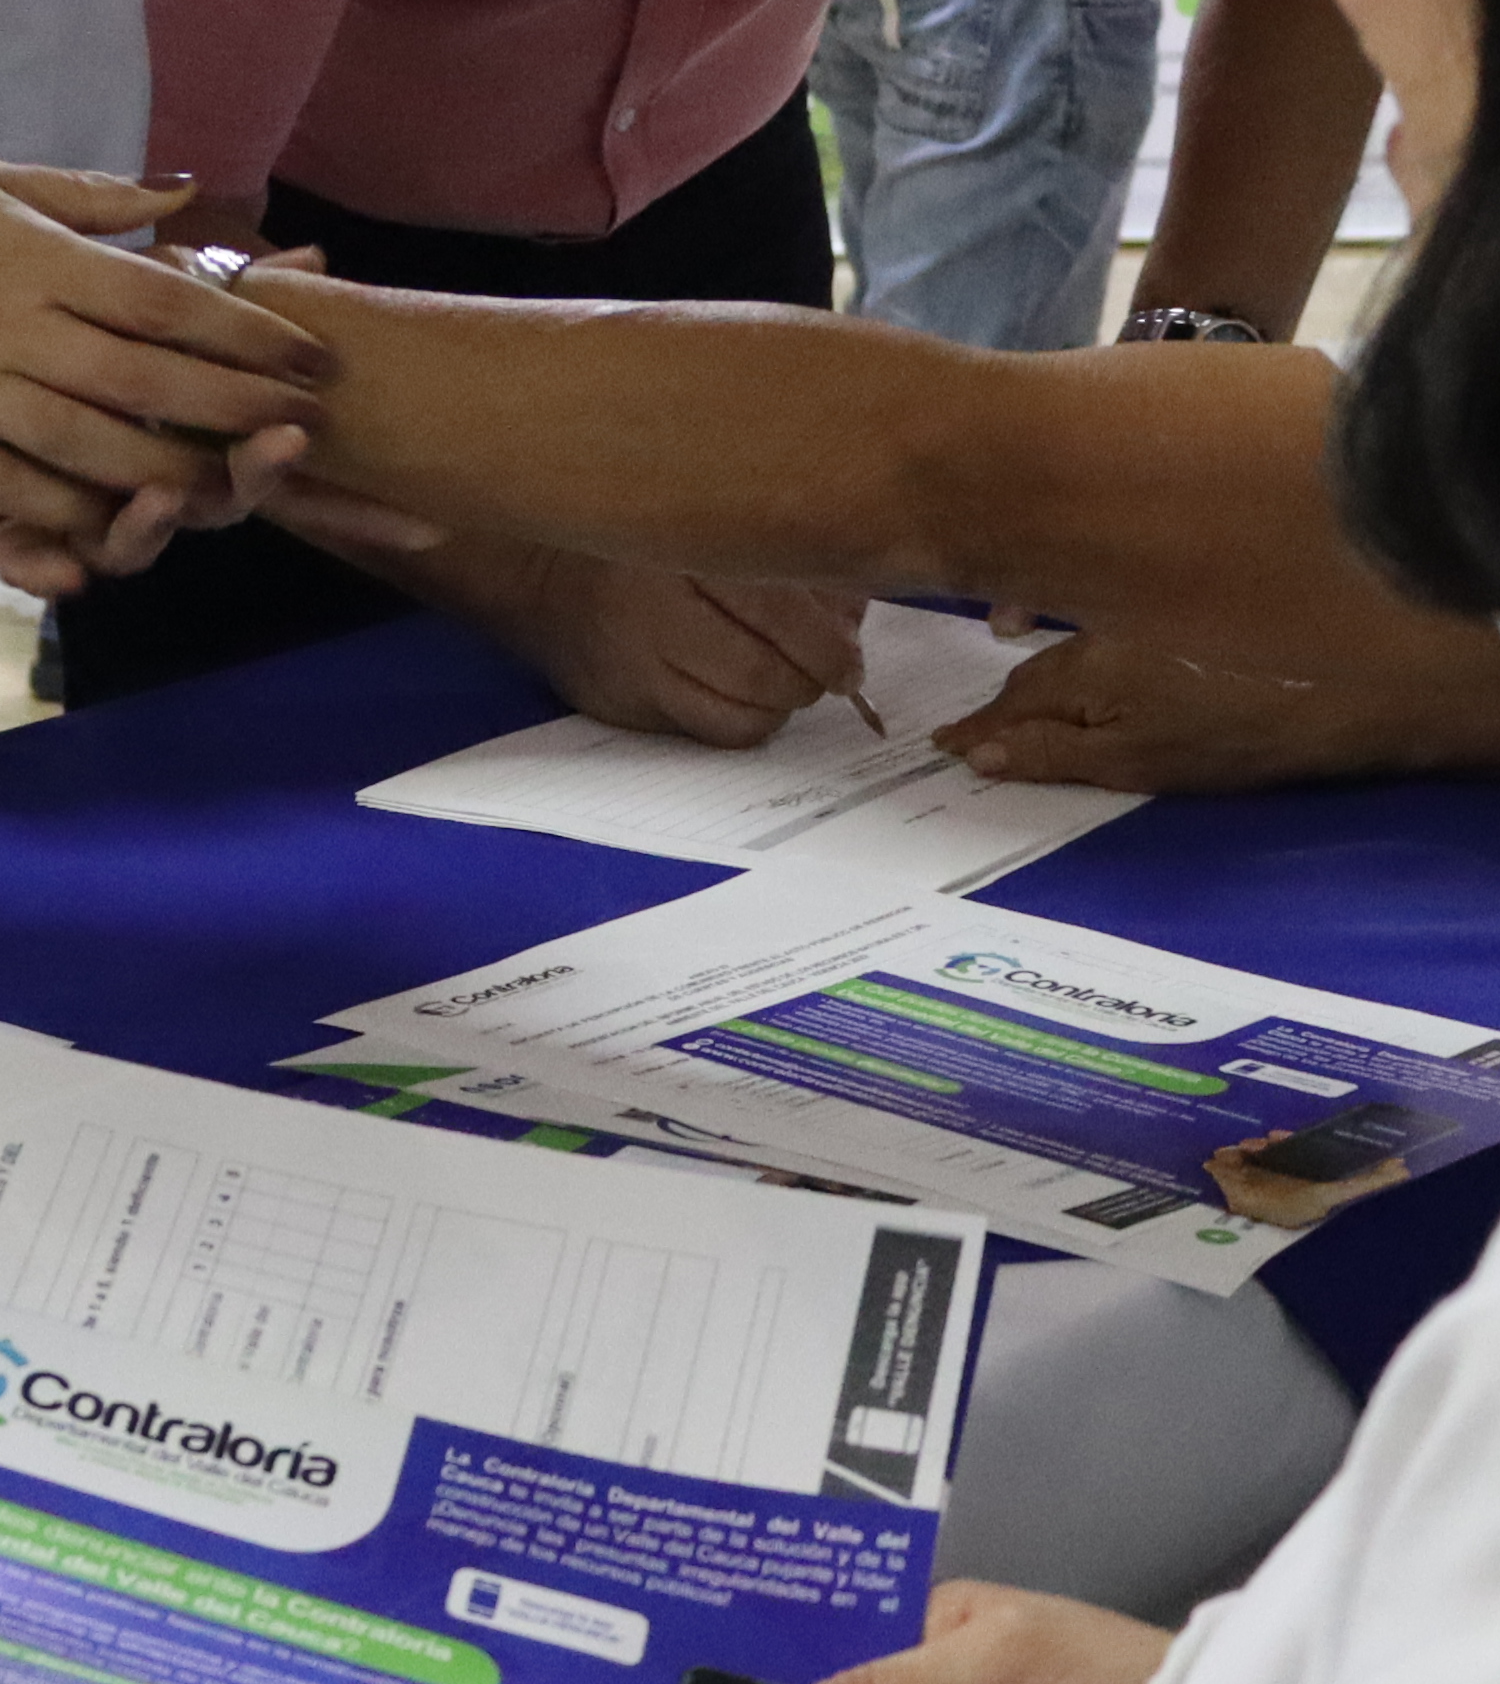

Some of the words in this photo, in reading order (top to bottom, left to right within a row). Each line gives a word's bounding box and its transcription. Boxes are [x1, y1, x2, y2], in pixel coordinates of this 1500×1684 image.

[1002, 964, 1200, 1031] Contraloría
[104, 1228, 129, 1274] siendo
[124, 1150, 160, 1217] deficiente
[20, 1370, 338, 1489] Contraloría
[481, 1455, 597, 1497] Contraloría
[605, 1484, 755, 1532] Departamental
[765, 1513, 801, 1538] del
[810, 1520, 864, 1547] Valle
[874, 1528, 910, 1552] del
[58, 1549, 113, 1584] del
[110, 1566, 190, 1609] Valle
[188, 1588, 245, 1624] del
[249, 1583, 283, 1610] la
[283, 1592, 455, 1665] Contraloría
